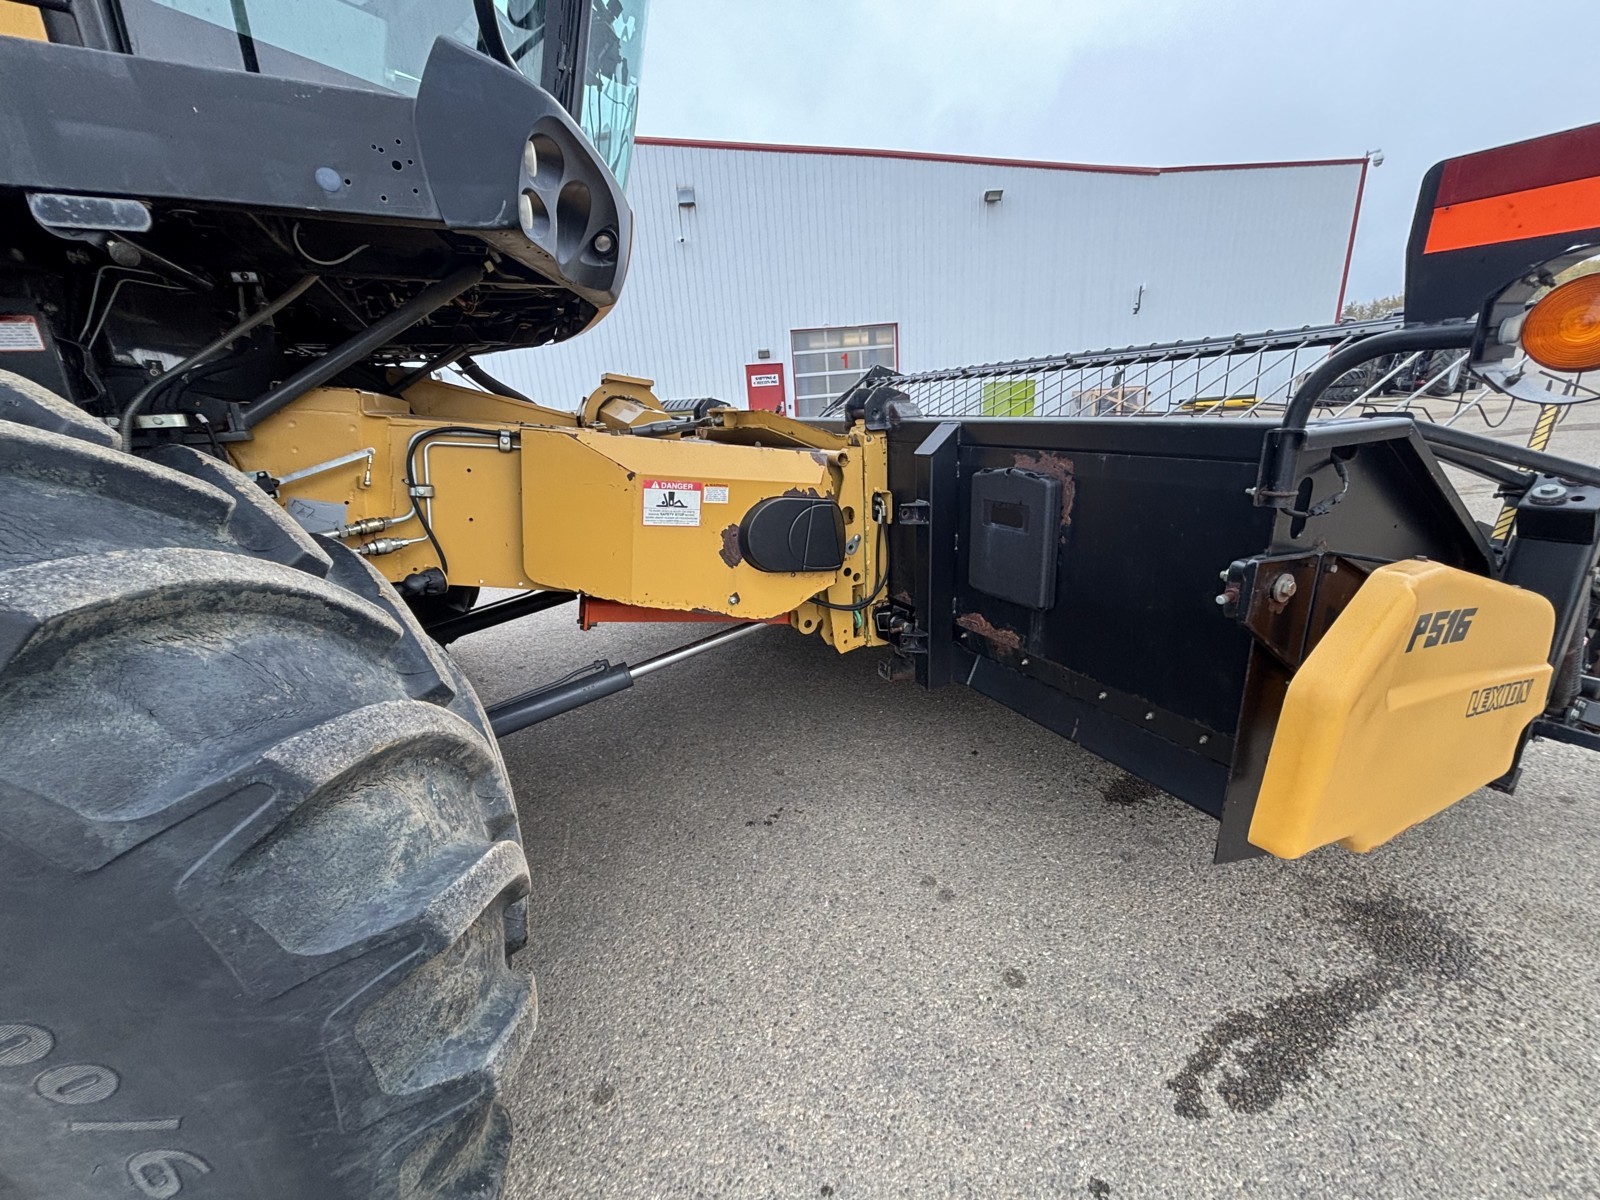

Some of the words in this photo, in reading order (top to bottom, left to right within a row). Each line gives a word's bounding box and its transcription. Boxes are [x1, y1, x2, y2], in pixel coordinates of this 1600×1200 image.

[841, 353, 848, 368] 1
[661, 482, 693, 490] DANGER
[1405, 607, 1478, 653] P516
[1465, 679, 1534, 718] LEXION
